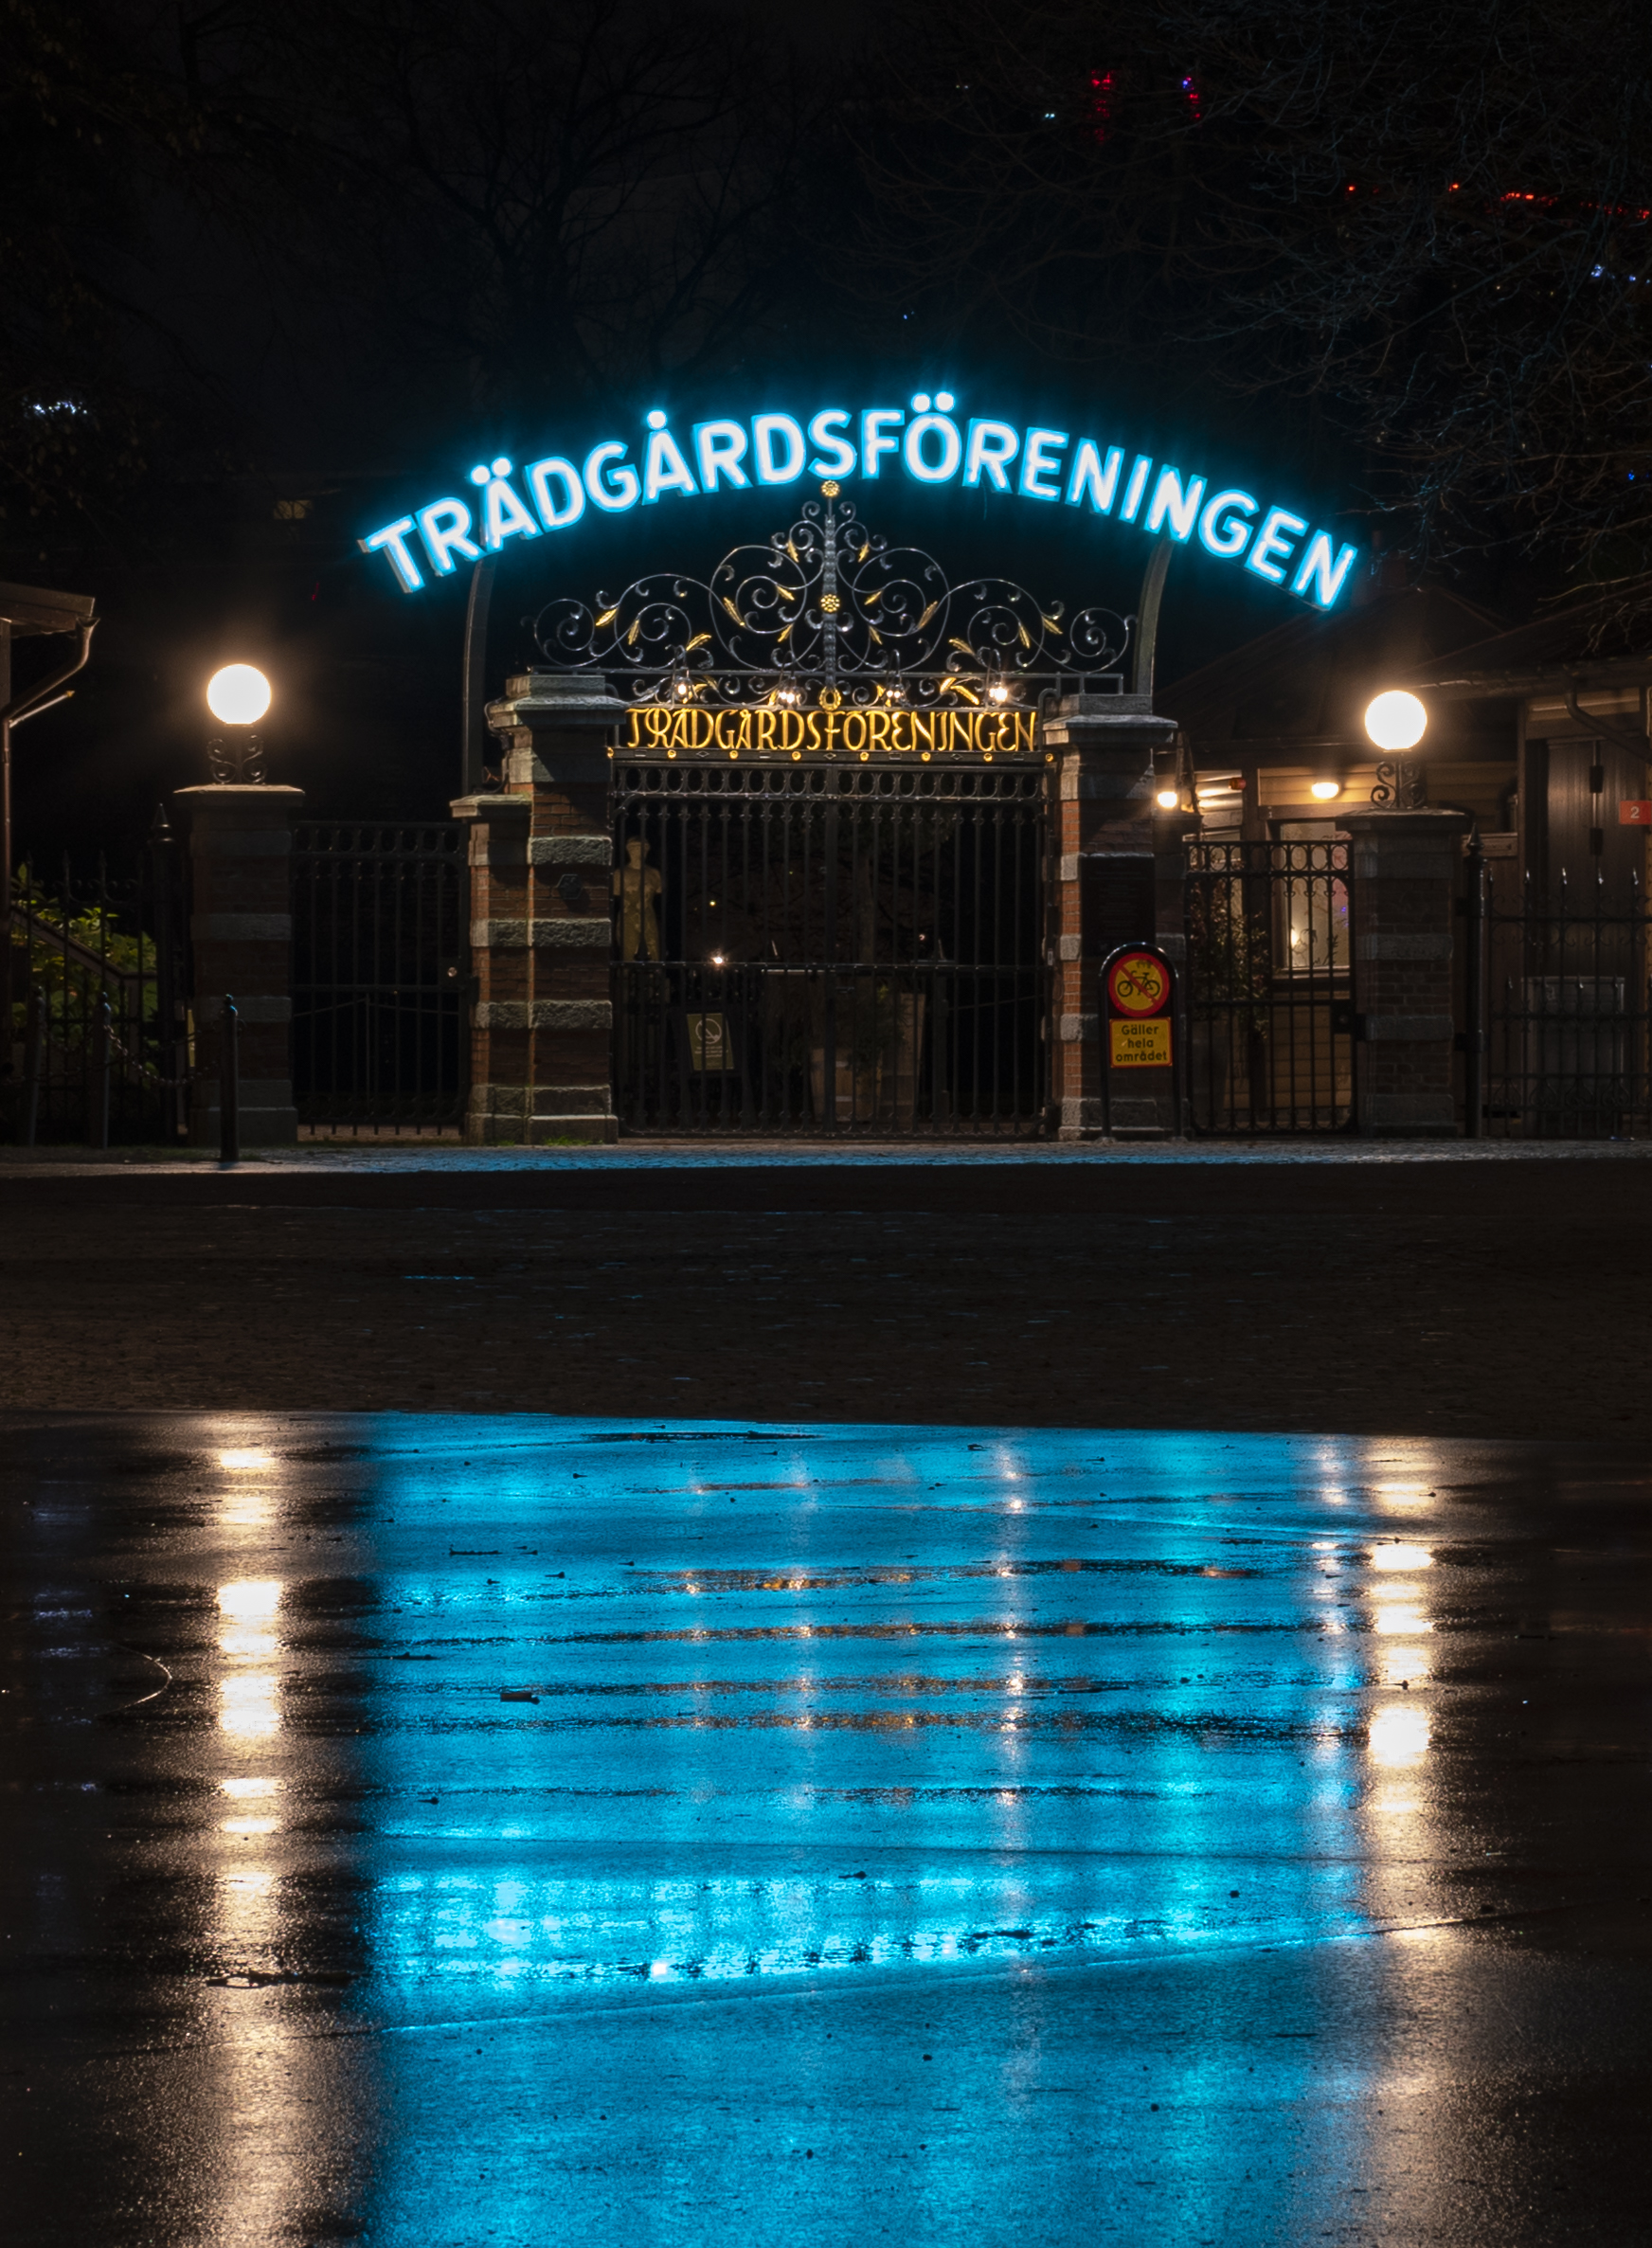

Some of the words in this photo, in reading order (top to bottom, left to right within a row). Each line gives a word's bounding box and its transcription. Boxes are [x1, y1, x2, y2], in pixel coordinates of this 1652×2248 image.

[359, 391, 1358, 611] TRÄDGÅRDSFÖRENINGEN
[1630, 805, 1641, 819] 2
[1121, 1024, 1159, 1035] Gäller
[1126, 1037, 1155, 1049] hela
[1115, 1050, 1167, 1062] området
